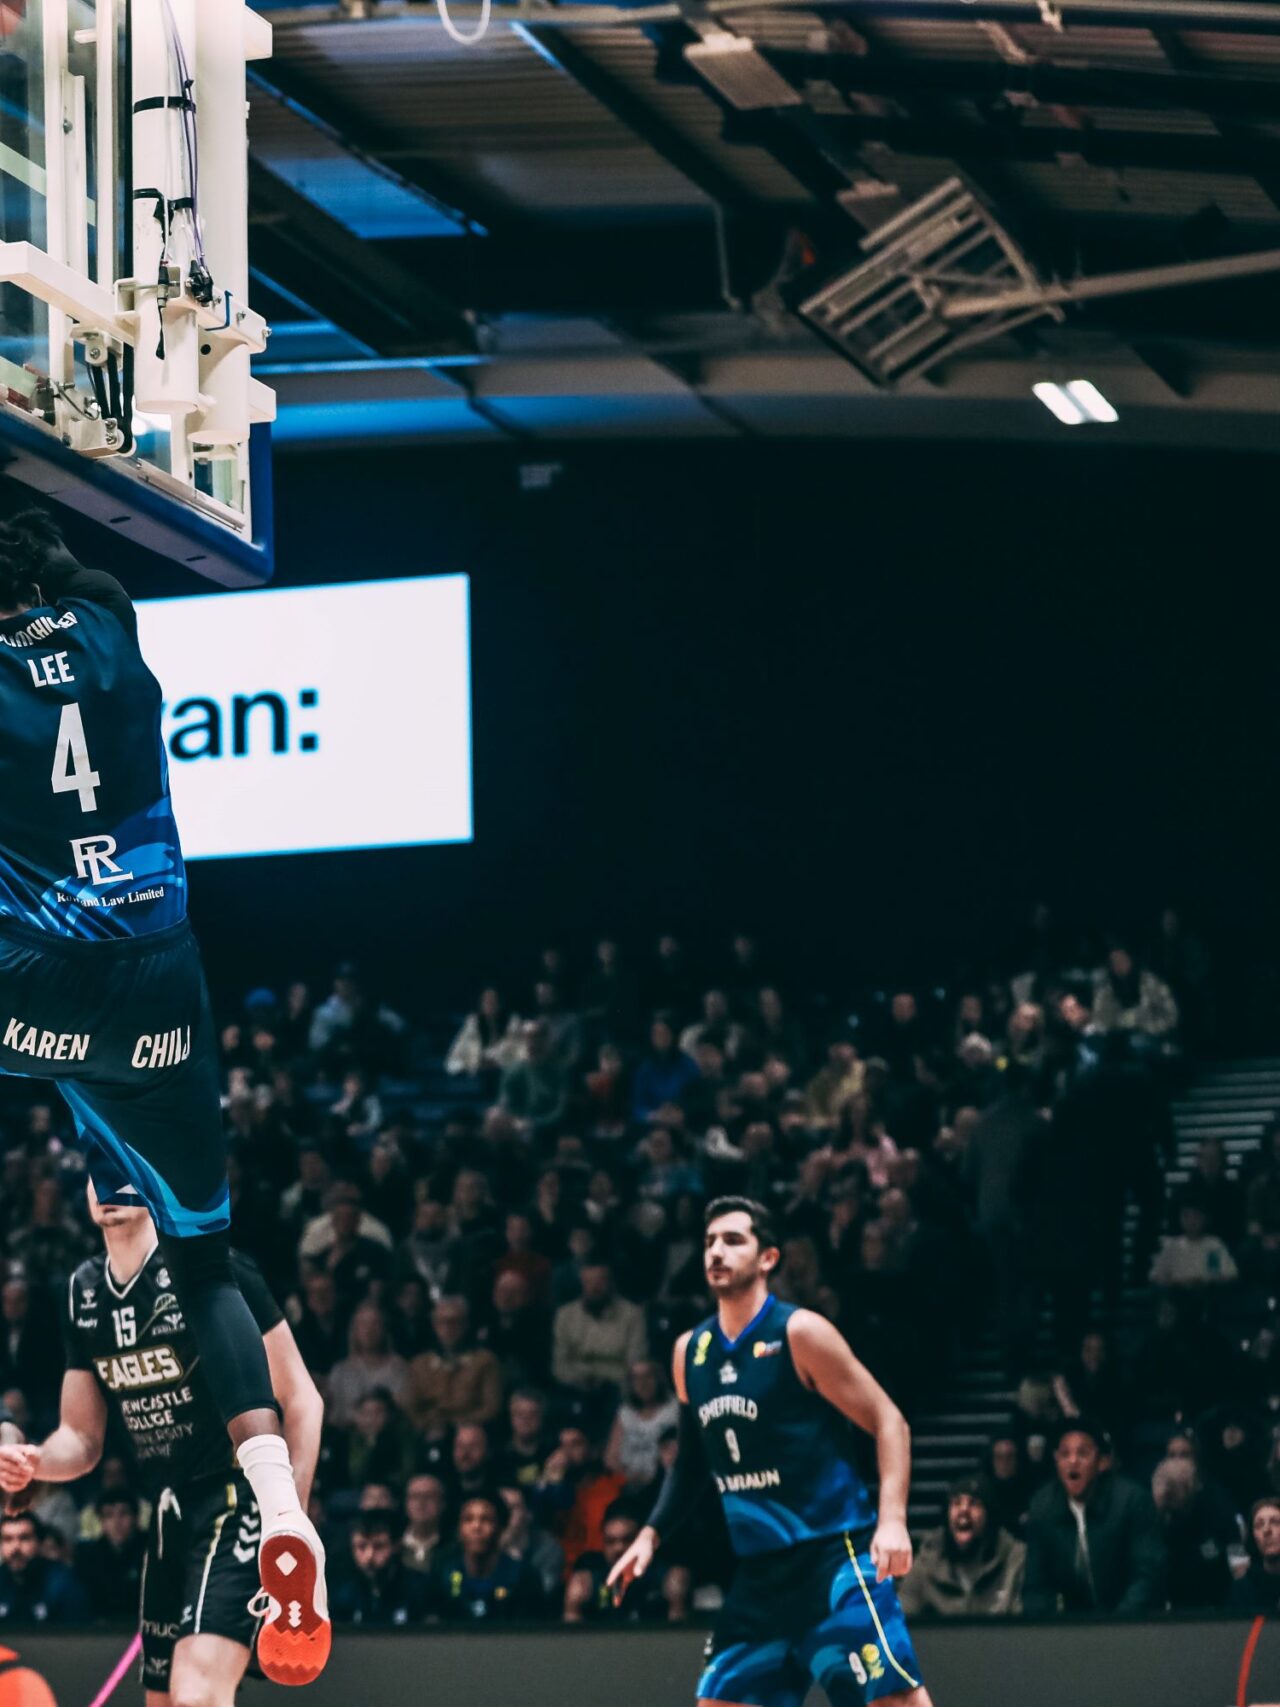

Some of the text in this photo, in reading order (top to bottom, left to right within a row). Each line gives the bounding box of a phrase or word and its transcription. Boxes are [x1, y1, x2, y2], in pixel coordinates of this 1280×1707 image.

[27, 650, 75, 688] LEE
[161, 688, 320, 763] an:
[51, 702, 101, 813] 4
[101, 894, 128, 907] Law
[127, 886, 166, 904] Limited
[2, 1017, 90, 1061] KAREN
[111, 1305, 138, 1349] 15
[96, 1347, 181, 1389] EAGLES
[848, 1651, 868, 1686] 9
